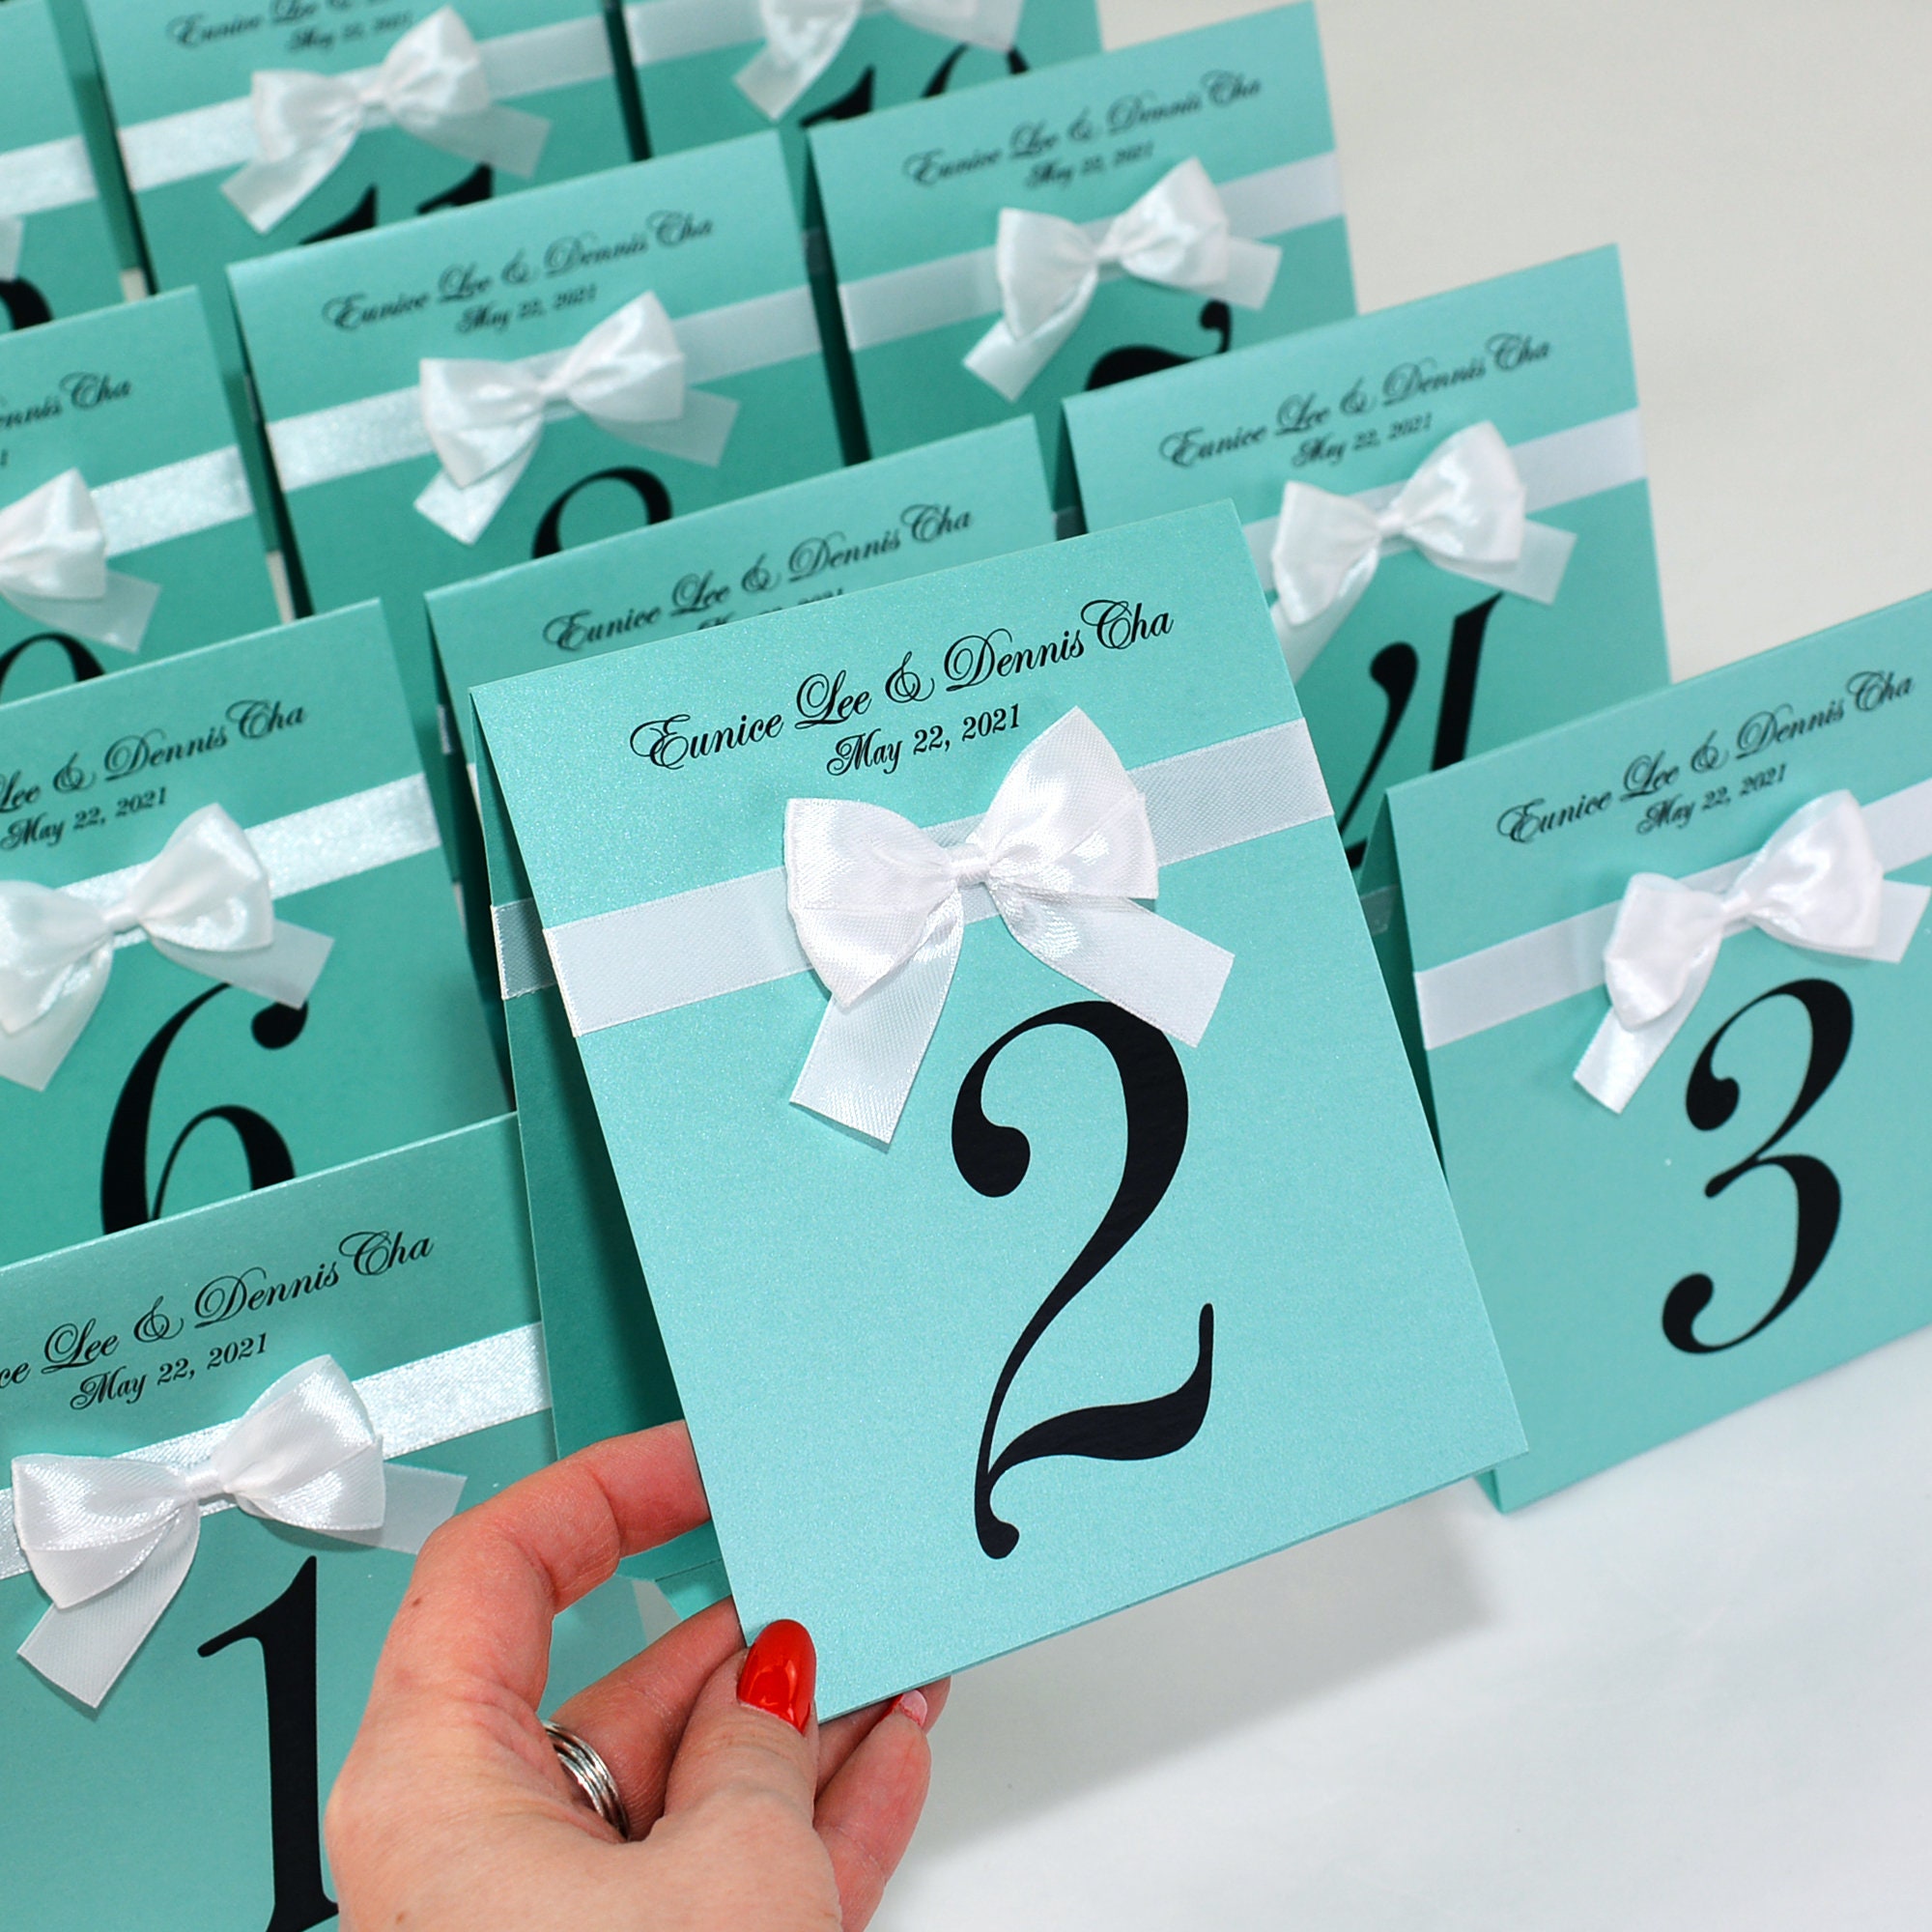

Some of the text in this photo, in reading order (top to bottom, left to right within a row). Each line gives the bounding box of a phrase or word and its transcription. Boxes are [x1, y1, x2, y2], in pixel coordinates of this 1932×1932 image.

[322, 210, 714, 330] Eunice Lee & Dennis Cha
[455, 306, 512, 334] May
[58, 371, 132, 410] Cha
[1158, 332, 1552, 468] Eunice Lee & Dennis Cha
[1291, 434, 1347, 468] May
[1388, 412, 1434, 440] 2021
[543, 610, 662, 651] Eunice
[670, 570, 730, 617] Lee
[740, 553, 780, 592] &
[788, 531, 901, 582] Dennis
[899, 503, 974, 543] Cha
[630, 599, 1174, 770] Eunice Lee & Dennis Cha
[826, 702, 1021, 776] May 22, 2021
[52, 752, 96, 794] &
[104, 727, 229, 781] Dennis
[225, 699, 306, 740] Cha
[1497, 670, 1916, 844] Eunice Lee & Dennis Cha
[1636, 763, 1788, 835] May 22, 2021
[0, 786, 168, 850] May 22, 2021
[1661, 978, 1854, 1354] 3
[41, 1230, 434, 1374] Lee & Dennis Cha
[952, 1001, 1214, 1559] 2
[70, 1365, 147, 1410] May
[156, 1357, 196, 1385] 22,
[207, 1332, 269, 1370] 2021
[197, 1555, 340, 1932] 1
